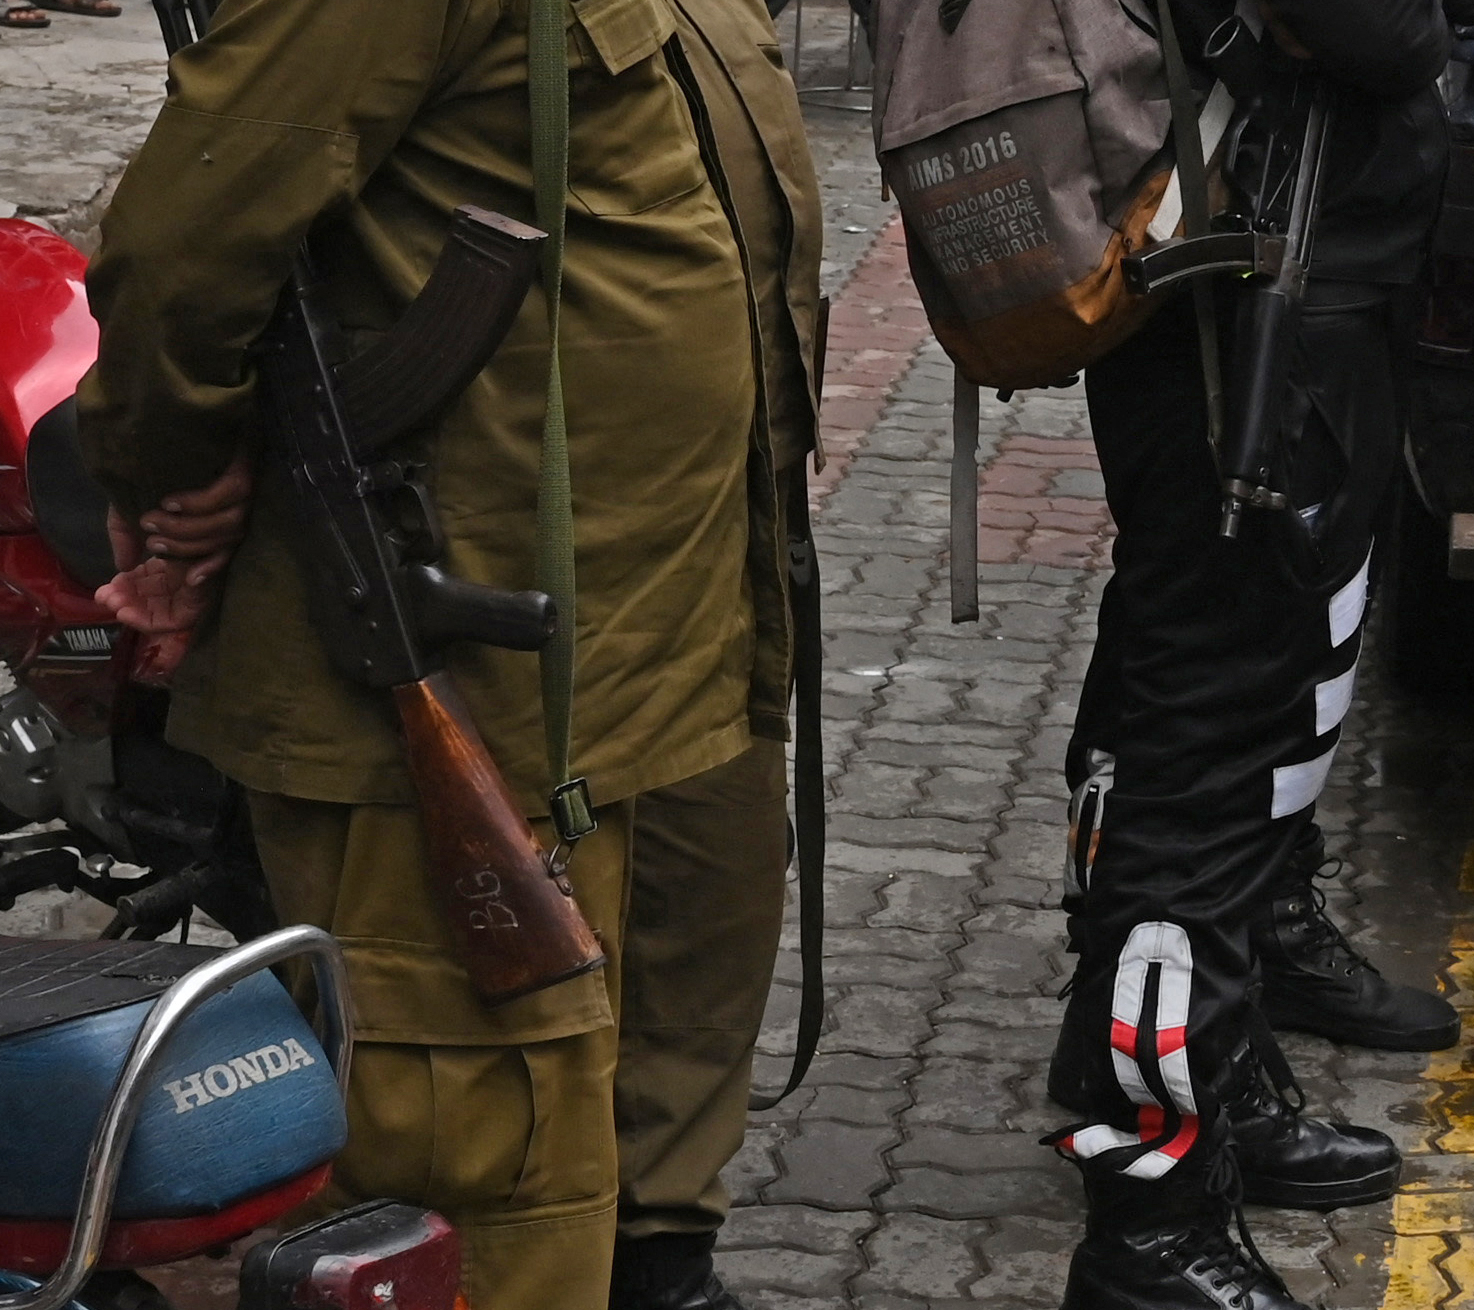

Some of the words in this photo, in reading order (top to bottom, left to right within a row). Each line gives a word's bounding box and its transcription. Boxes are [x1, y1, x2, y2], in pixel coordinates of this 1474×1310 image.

[907, 152, 955, 192] AIMS
[959, 131, 1017, 175] 2016
[922, 178, 1032, 228] AUTONOMOUS
[971, 228, 1049, 267] SECURITY
[162, 1037, 316, 1114] HONDA
